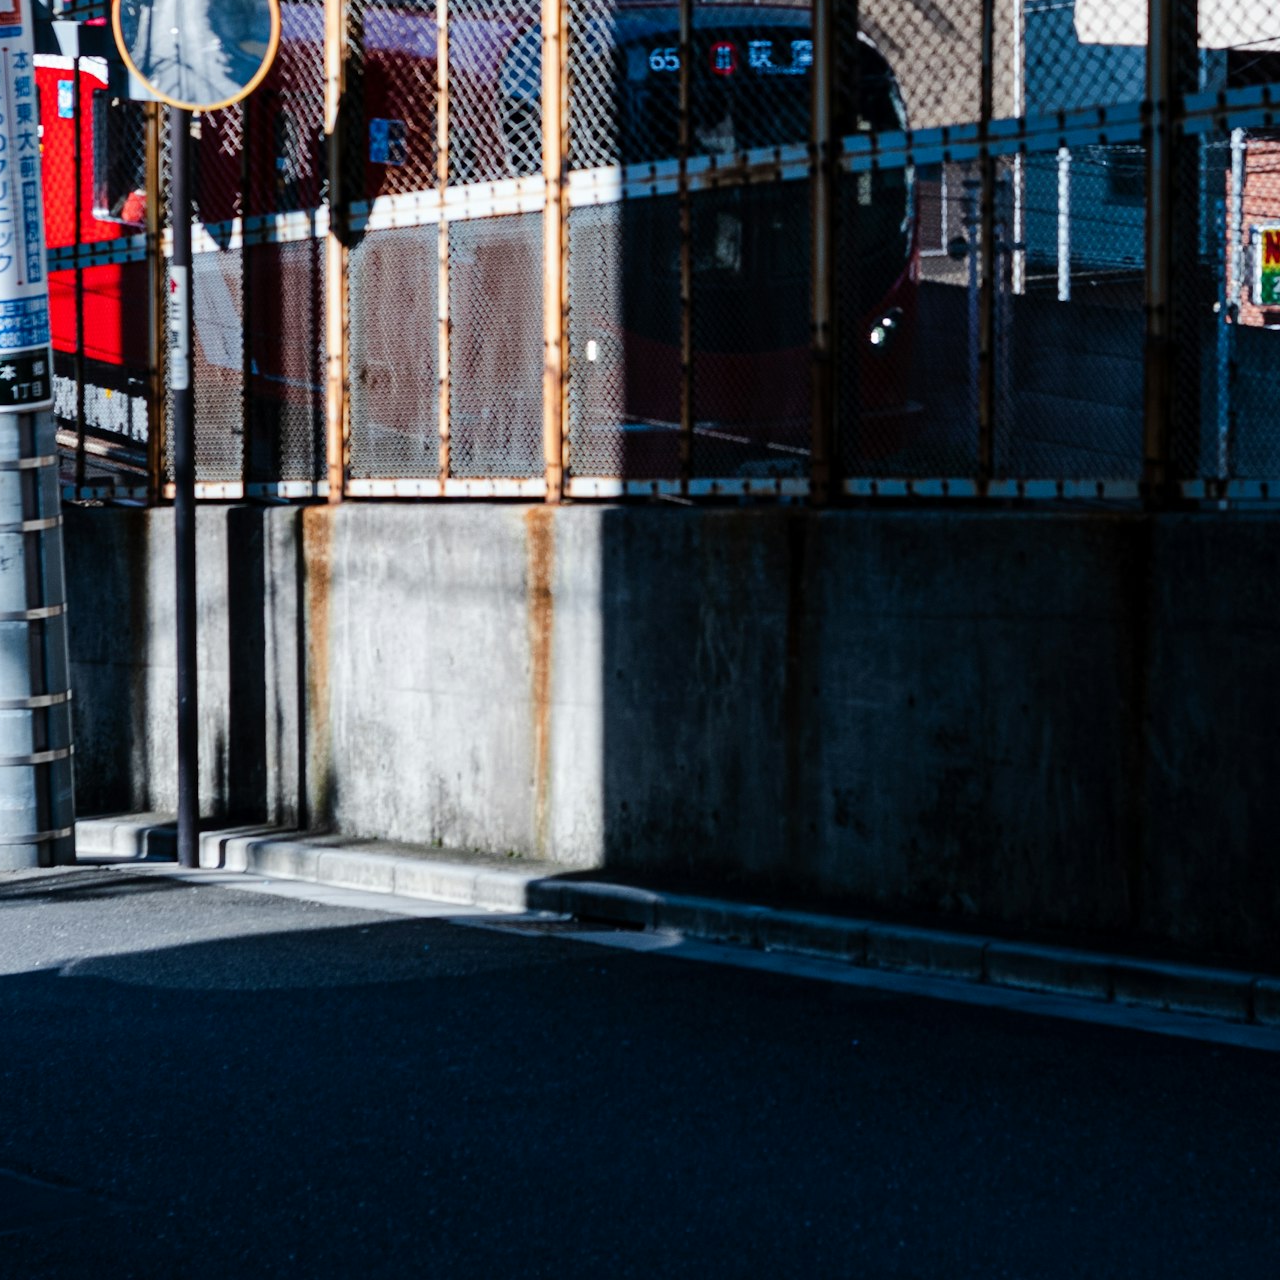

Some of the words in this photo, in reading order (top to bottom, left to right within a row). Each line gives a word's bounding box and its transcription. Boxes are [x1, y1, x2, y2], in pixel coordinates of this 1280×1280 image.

[13, 51, 36, 177] 本郷東大前
[10, 381, 43, 400] 1丁目
